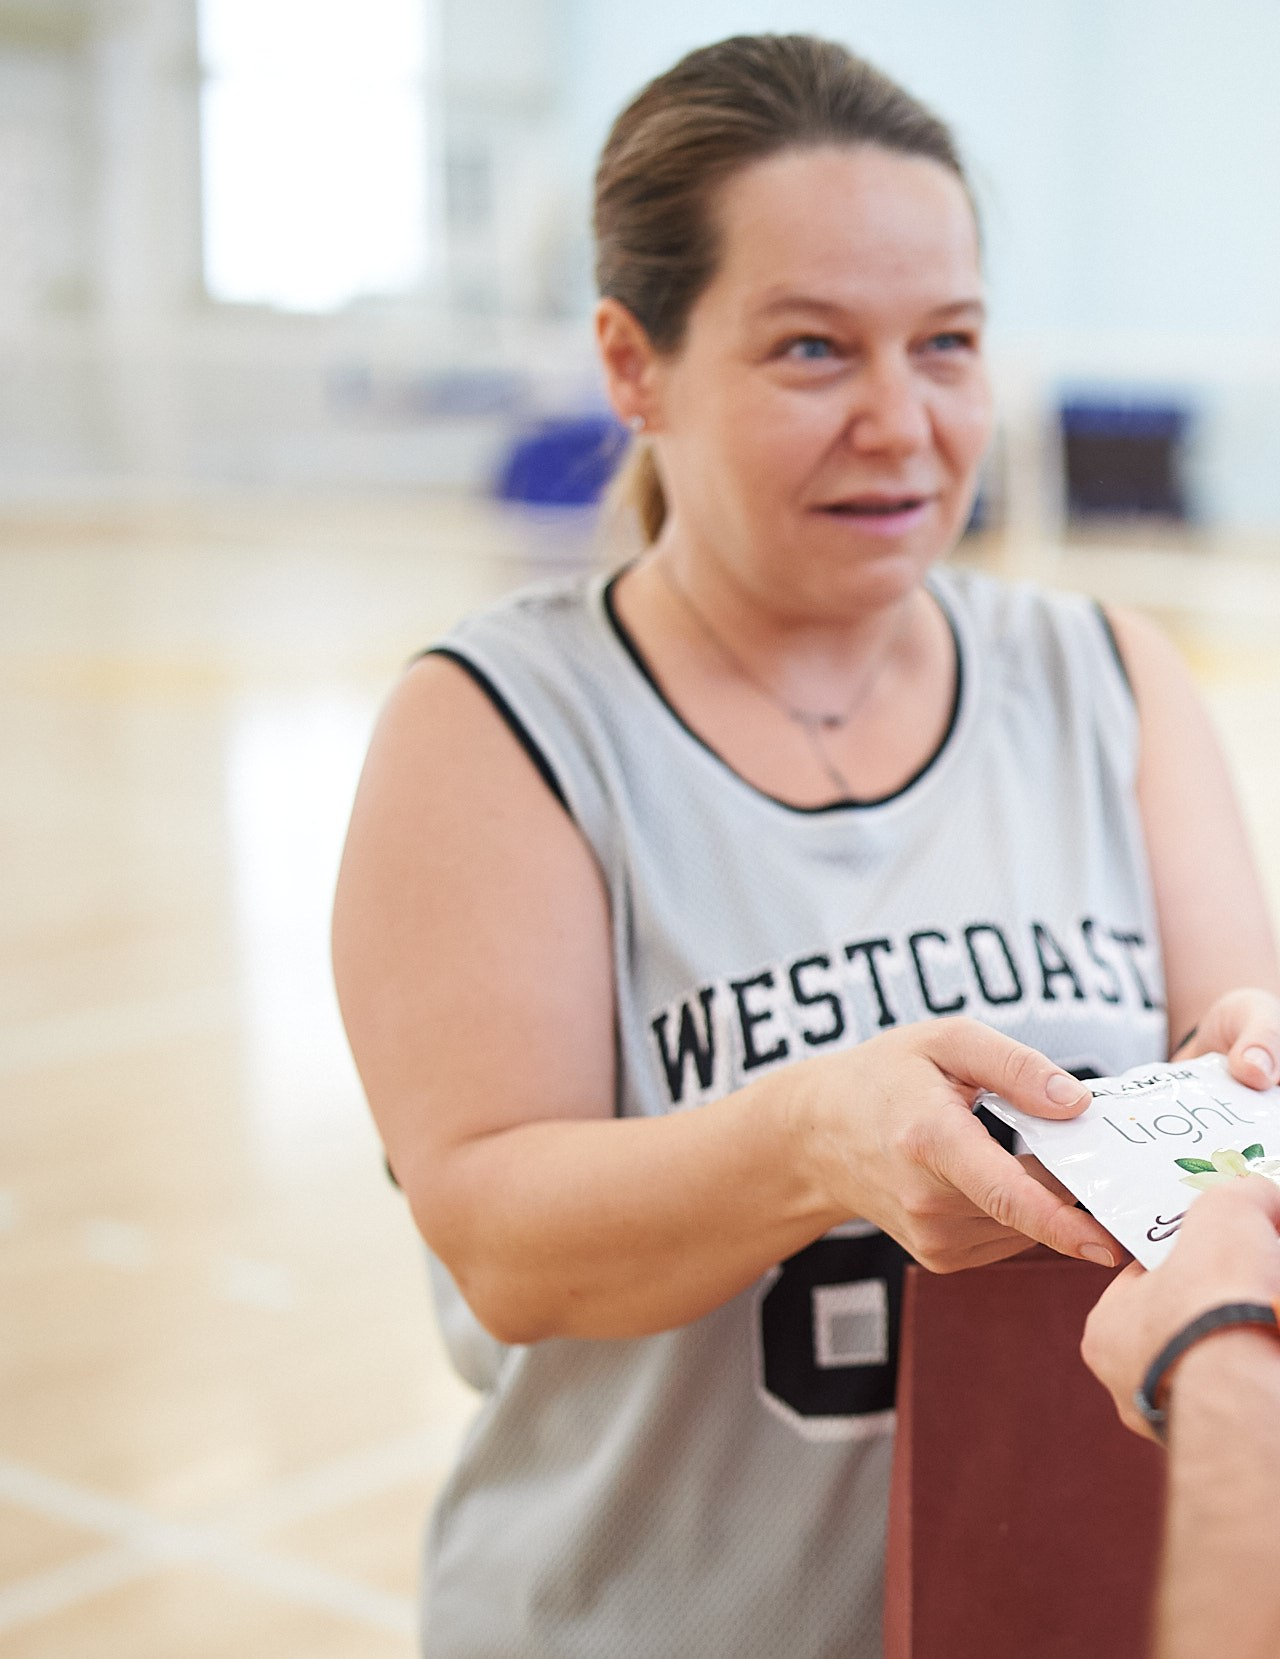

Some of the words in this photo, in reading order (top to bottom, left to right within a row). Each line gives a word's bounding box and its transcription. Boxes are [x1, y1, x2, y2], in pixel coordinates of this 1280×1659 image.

[650, 915, 1166, 1105] WESTCOAST
[1092, 1069, 1200, 1098] ALANCER
[1102, 1095, 1255, 1144] light
